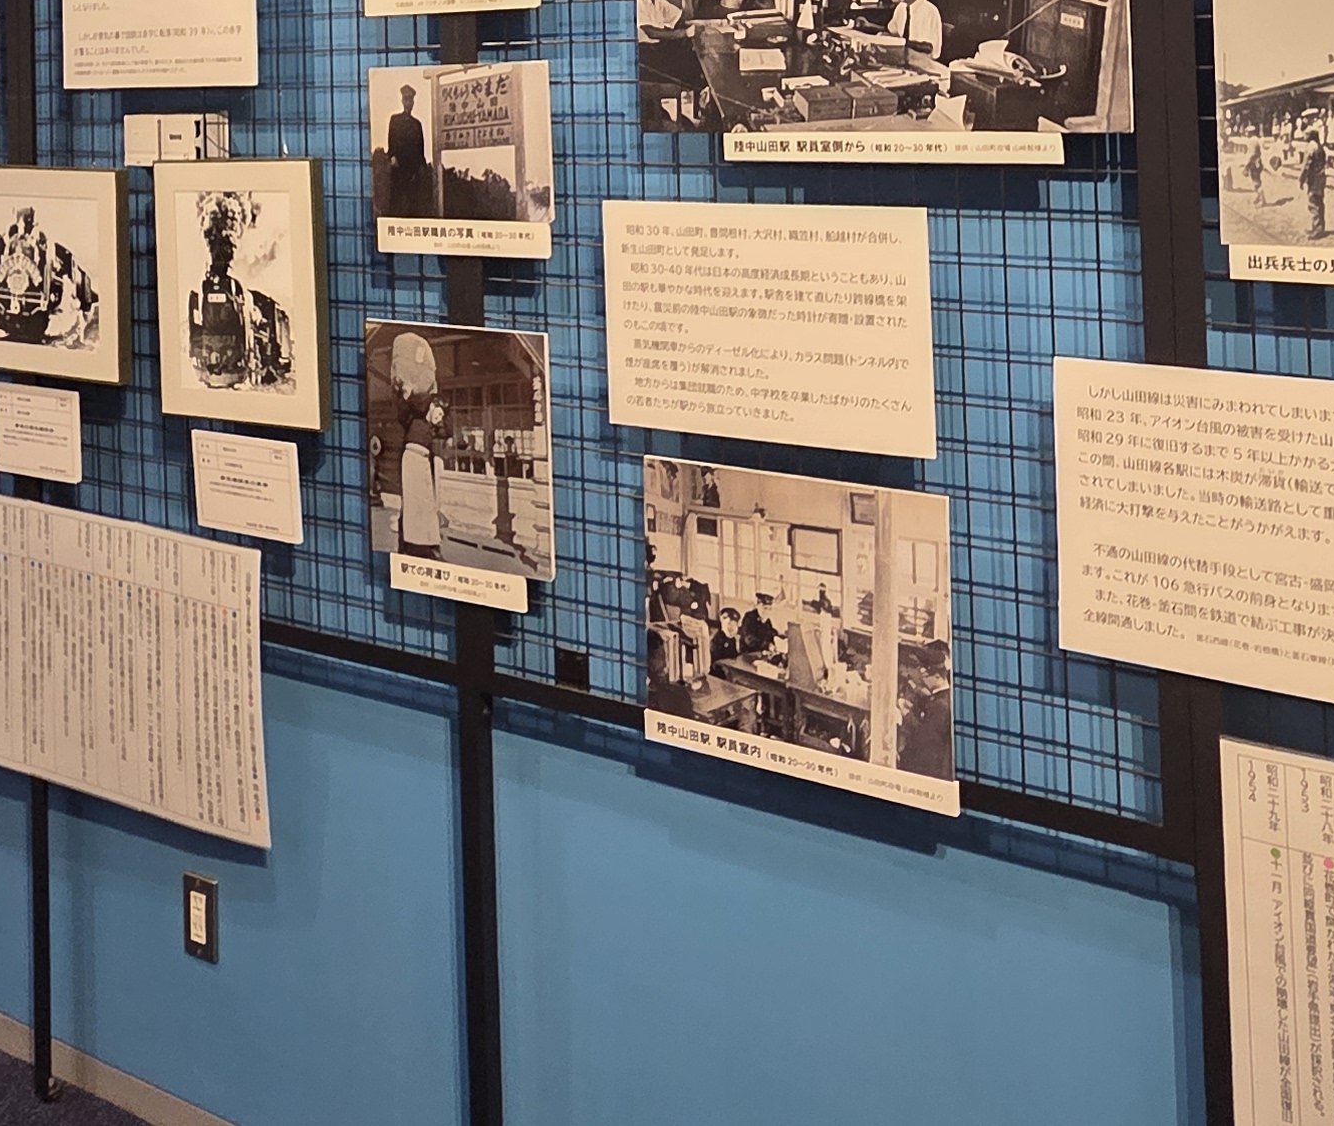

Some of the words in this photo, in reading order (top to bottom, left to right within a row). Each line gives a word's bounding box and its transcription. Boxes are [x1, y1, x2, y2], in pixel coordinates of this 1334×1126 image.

[733, 140, 791, 153] 陸中山田駅
[796, 140, 866, 153] 駅員室側から
[1247, 760, 1257, 803] 1954
[1266, 764, 1281, 833] 昭和二十九年
[1300, 768, 1310, 813] 1953
[1319, 774, 1334, 844] 昭和二十八年
